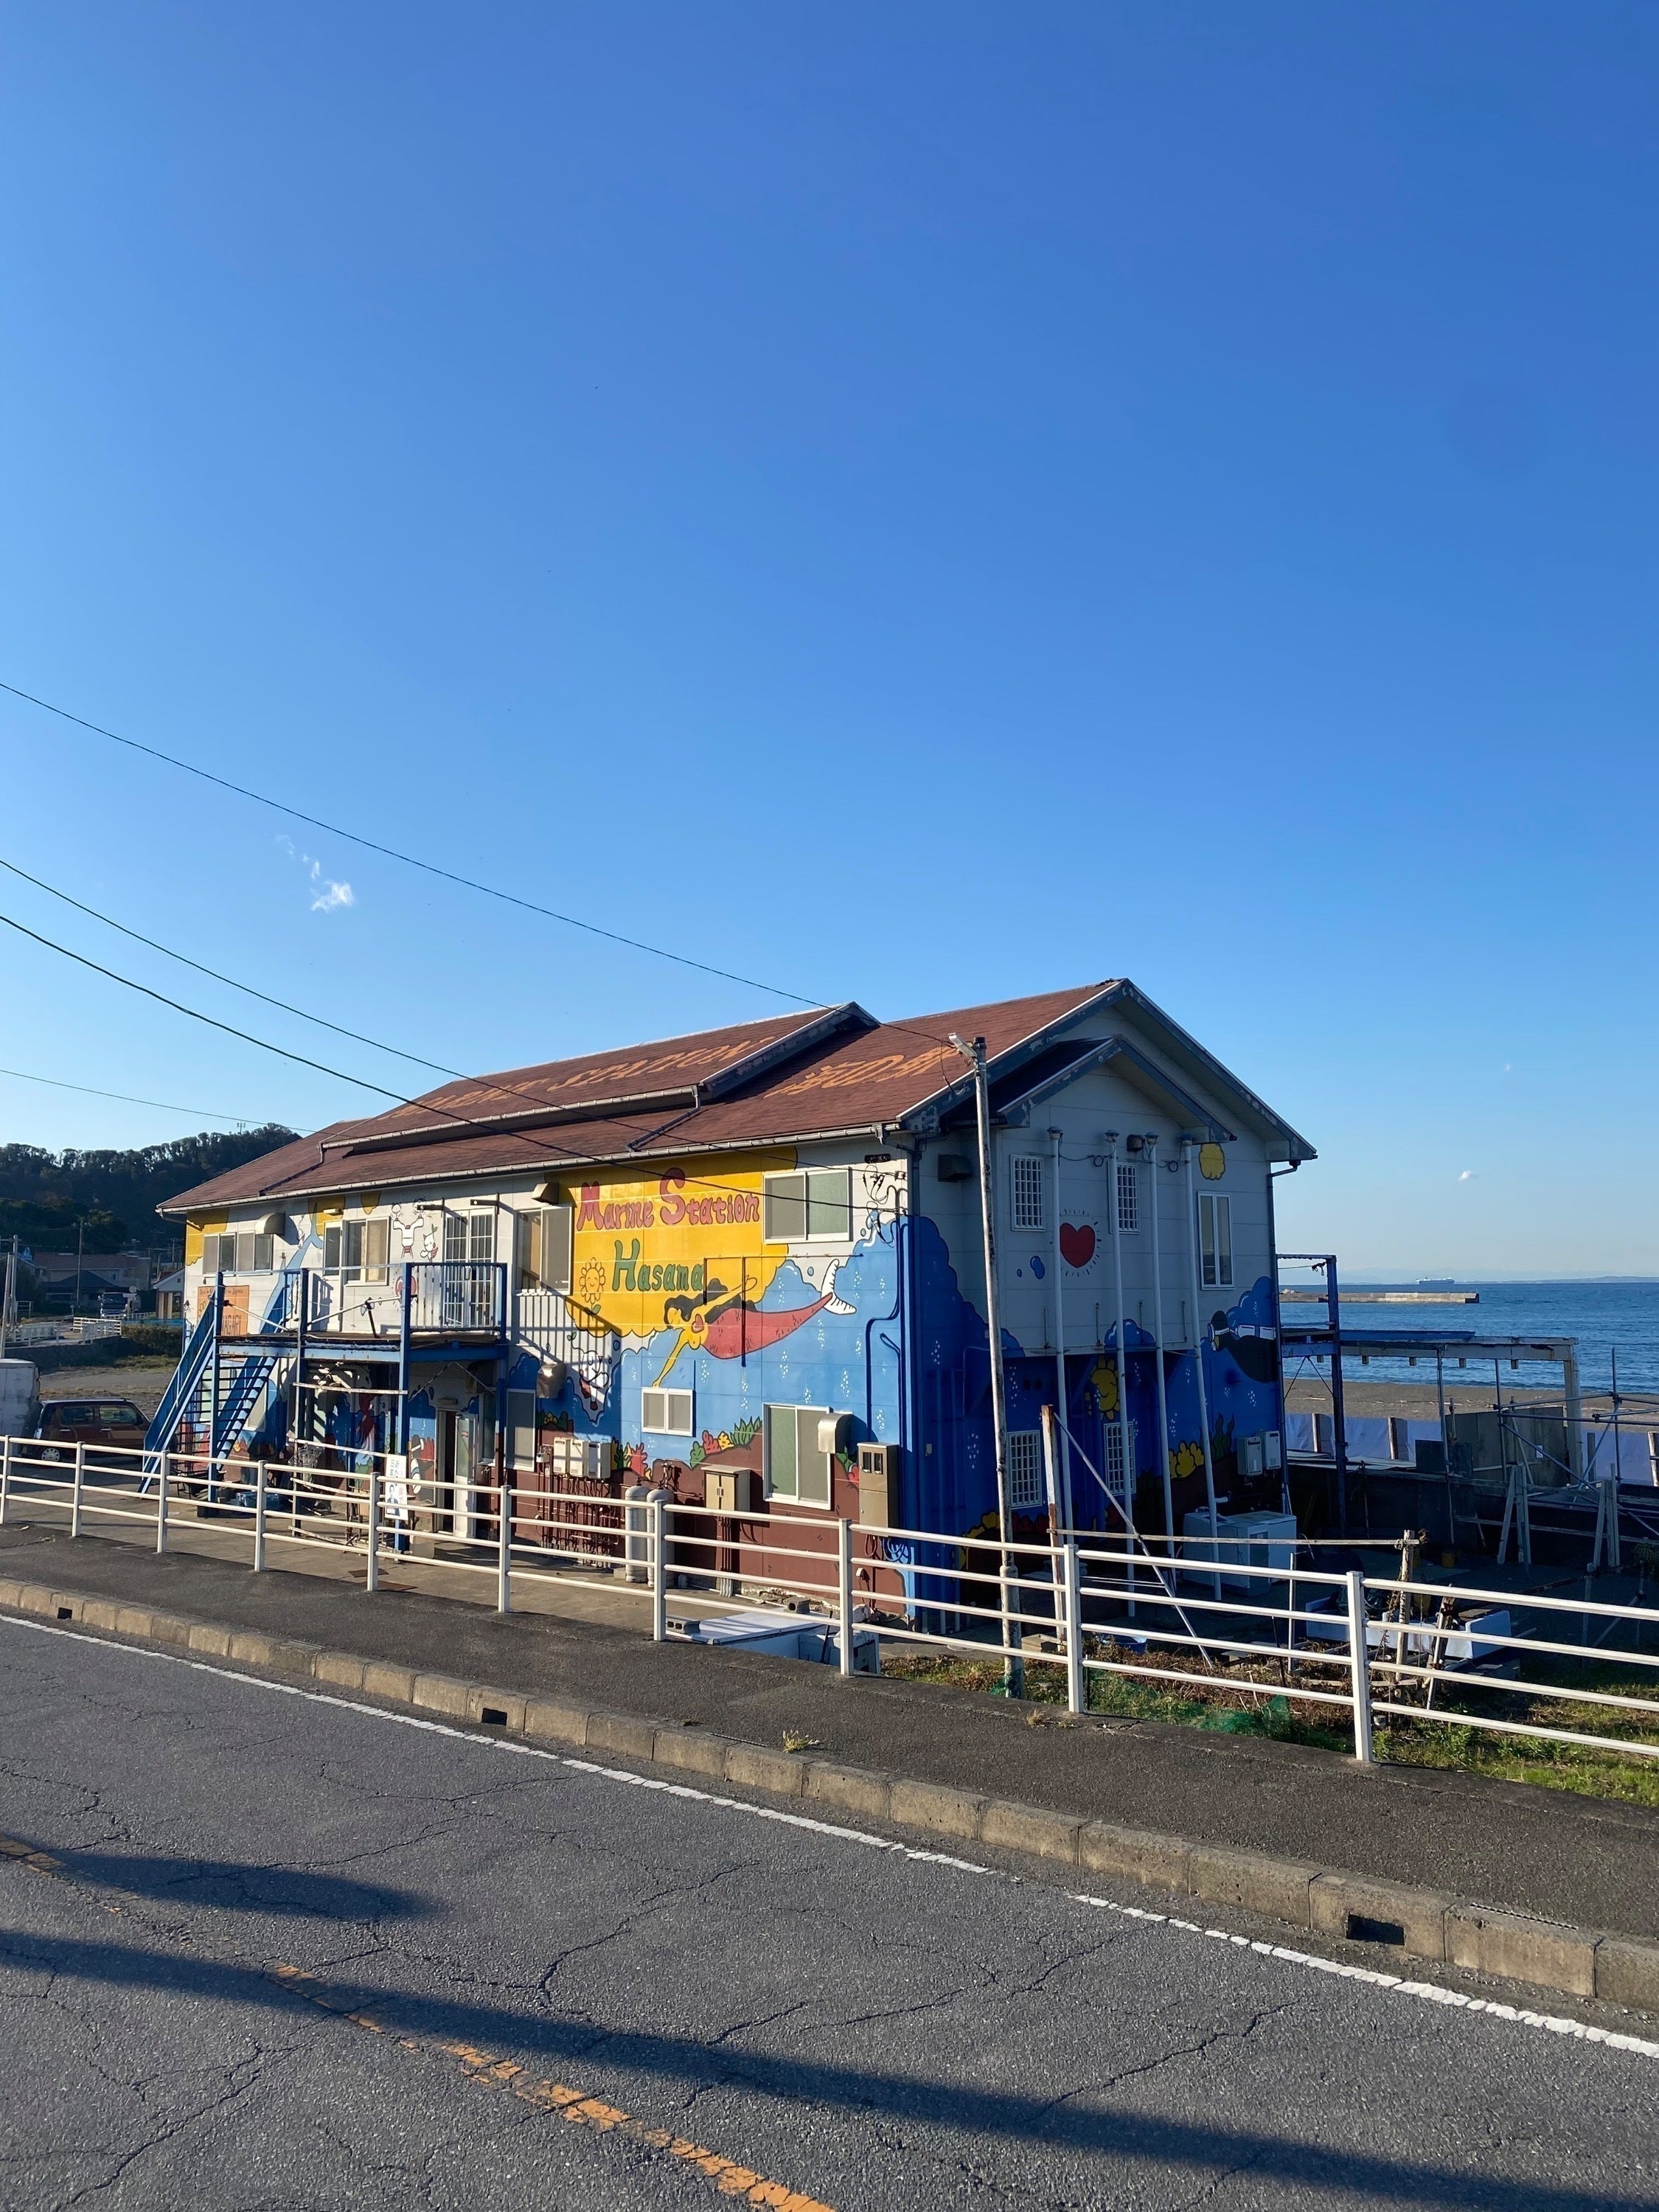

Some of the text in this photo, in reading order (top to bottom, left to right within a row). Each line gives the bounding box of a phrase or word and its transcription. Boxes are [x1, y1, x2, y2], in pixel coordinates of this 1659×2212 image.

[546, 1035, 776, 1092] STATION
[576, 1167, 760, 1231] Marine Station
[611, 1238, 703, 1292] Hasama
